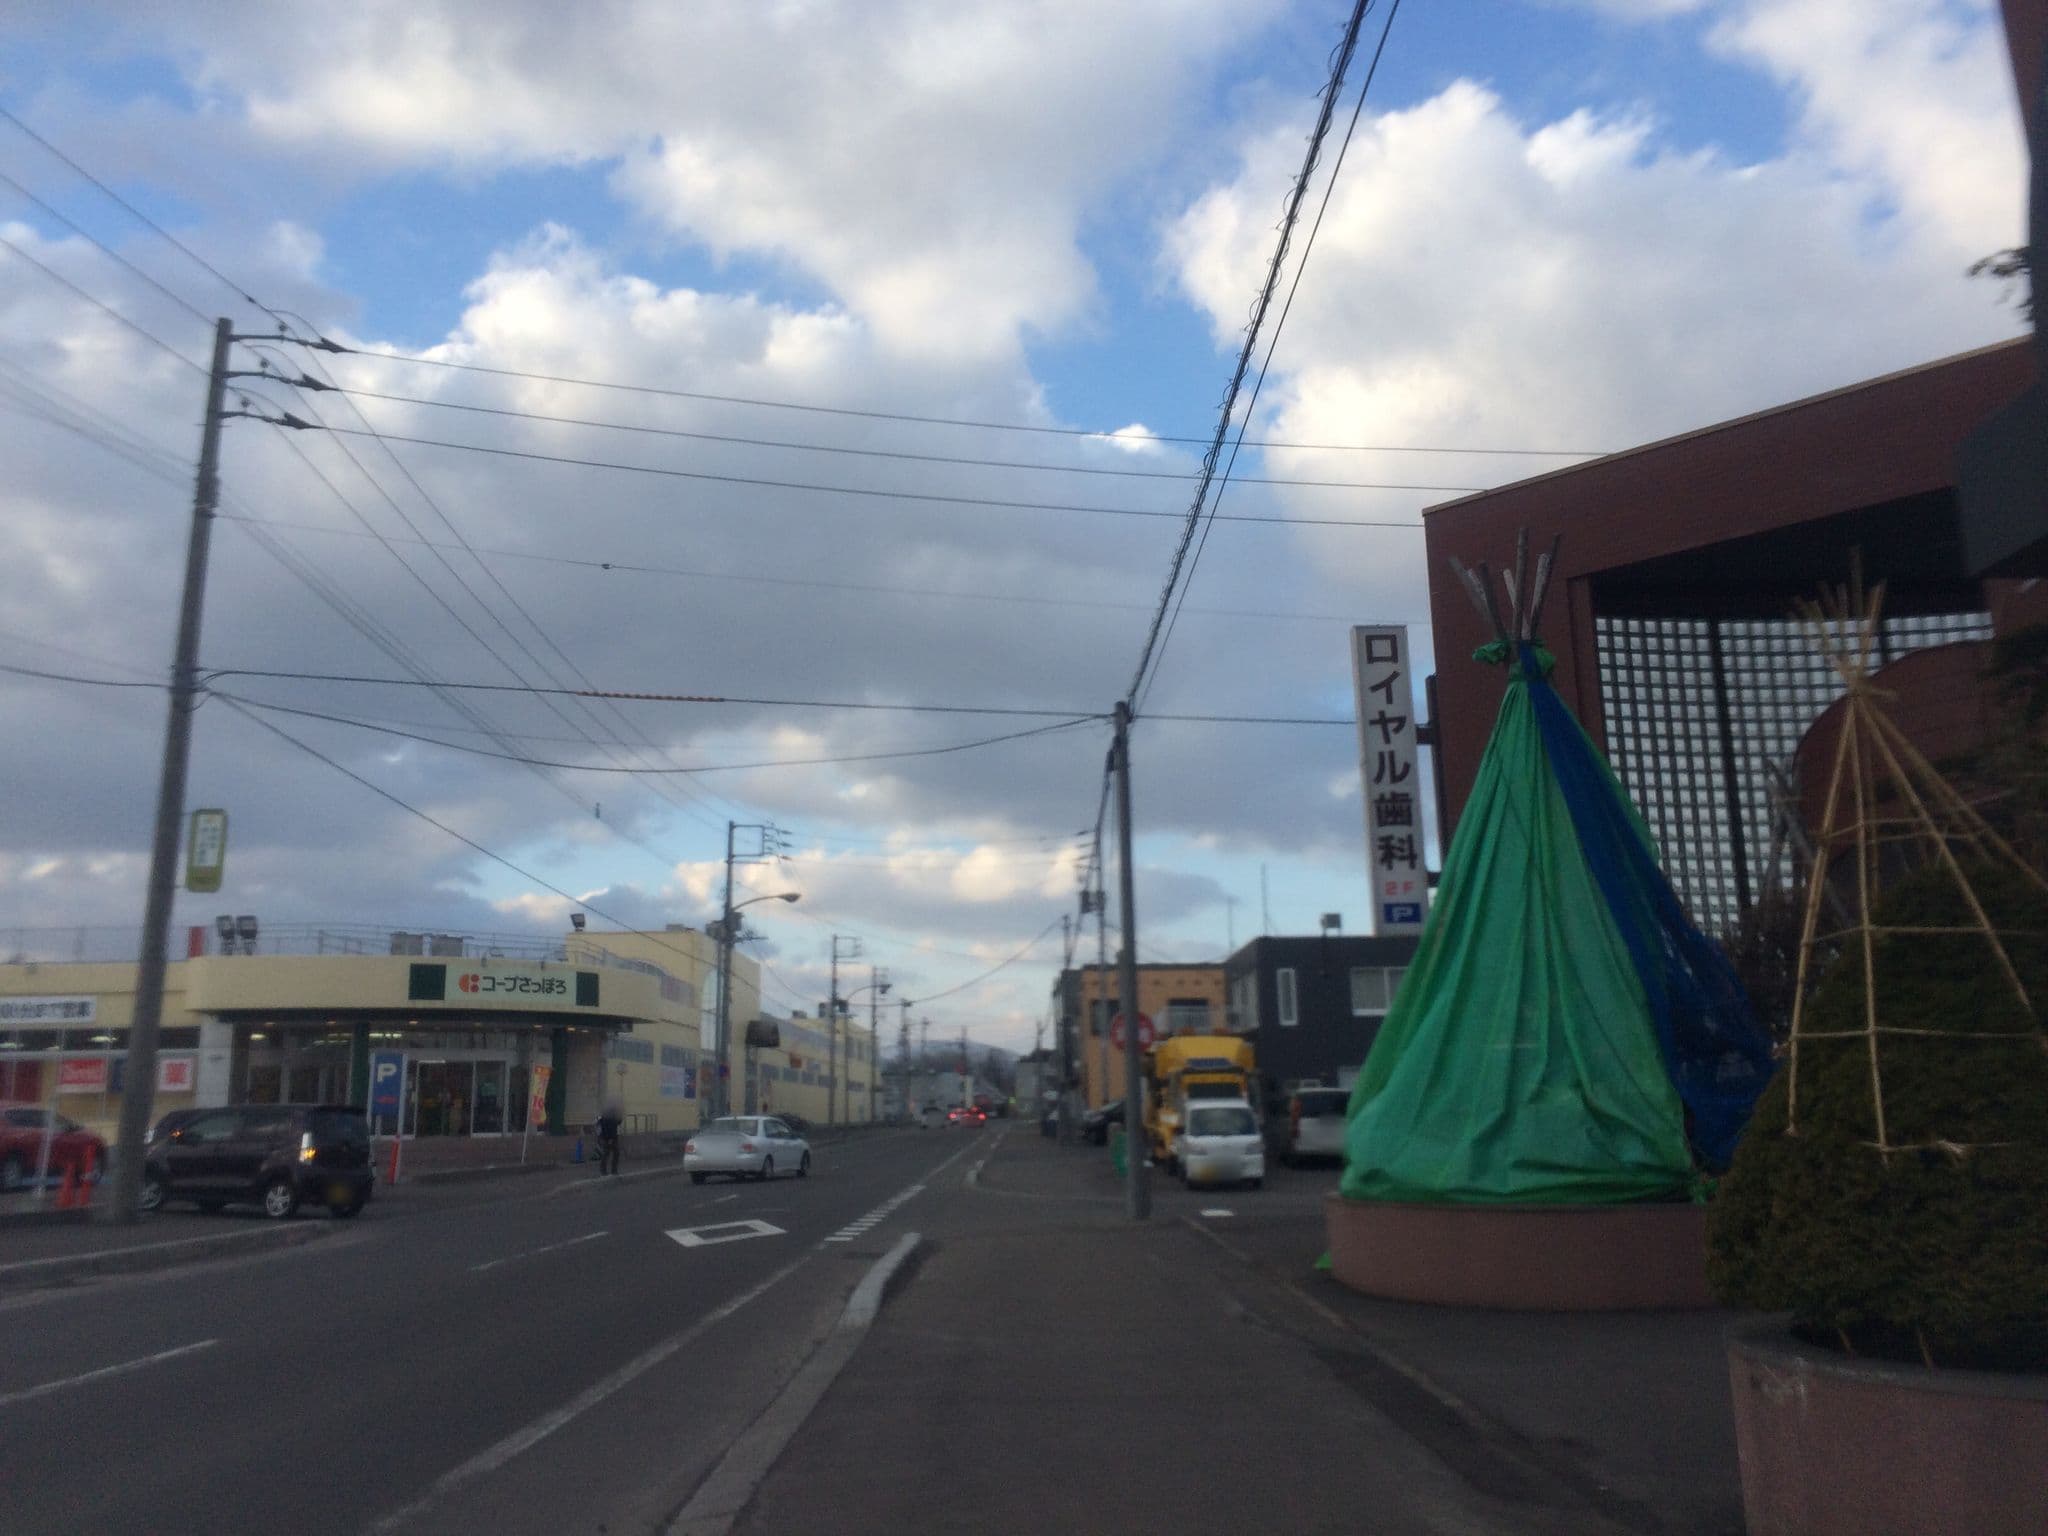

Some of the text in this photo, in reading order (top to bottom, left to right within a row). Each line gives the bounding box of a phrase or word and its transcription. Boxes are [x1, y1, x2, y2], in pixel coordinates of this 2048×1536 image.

[1365, 634, 1418, 871] ロイヤル歯科
[483, 975, 567, 994] コープさっぽろ
[377, 1063, 397, 1082] P
